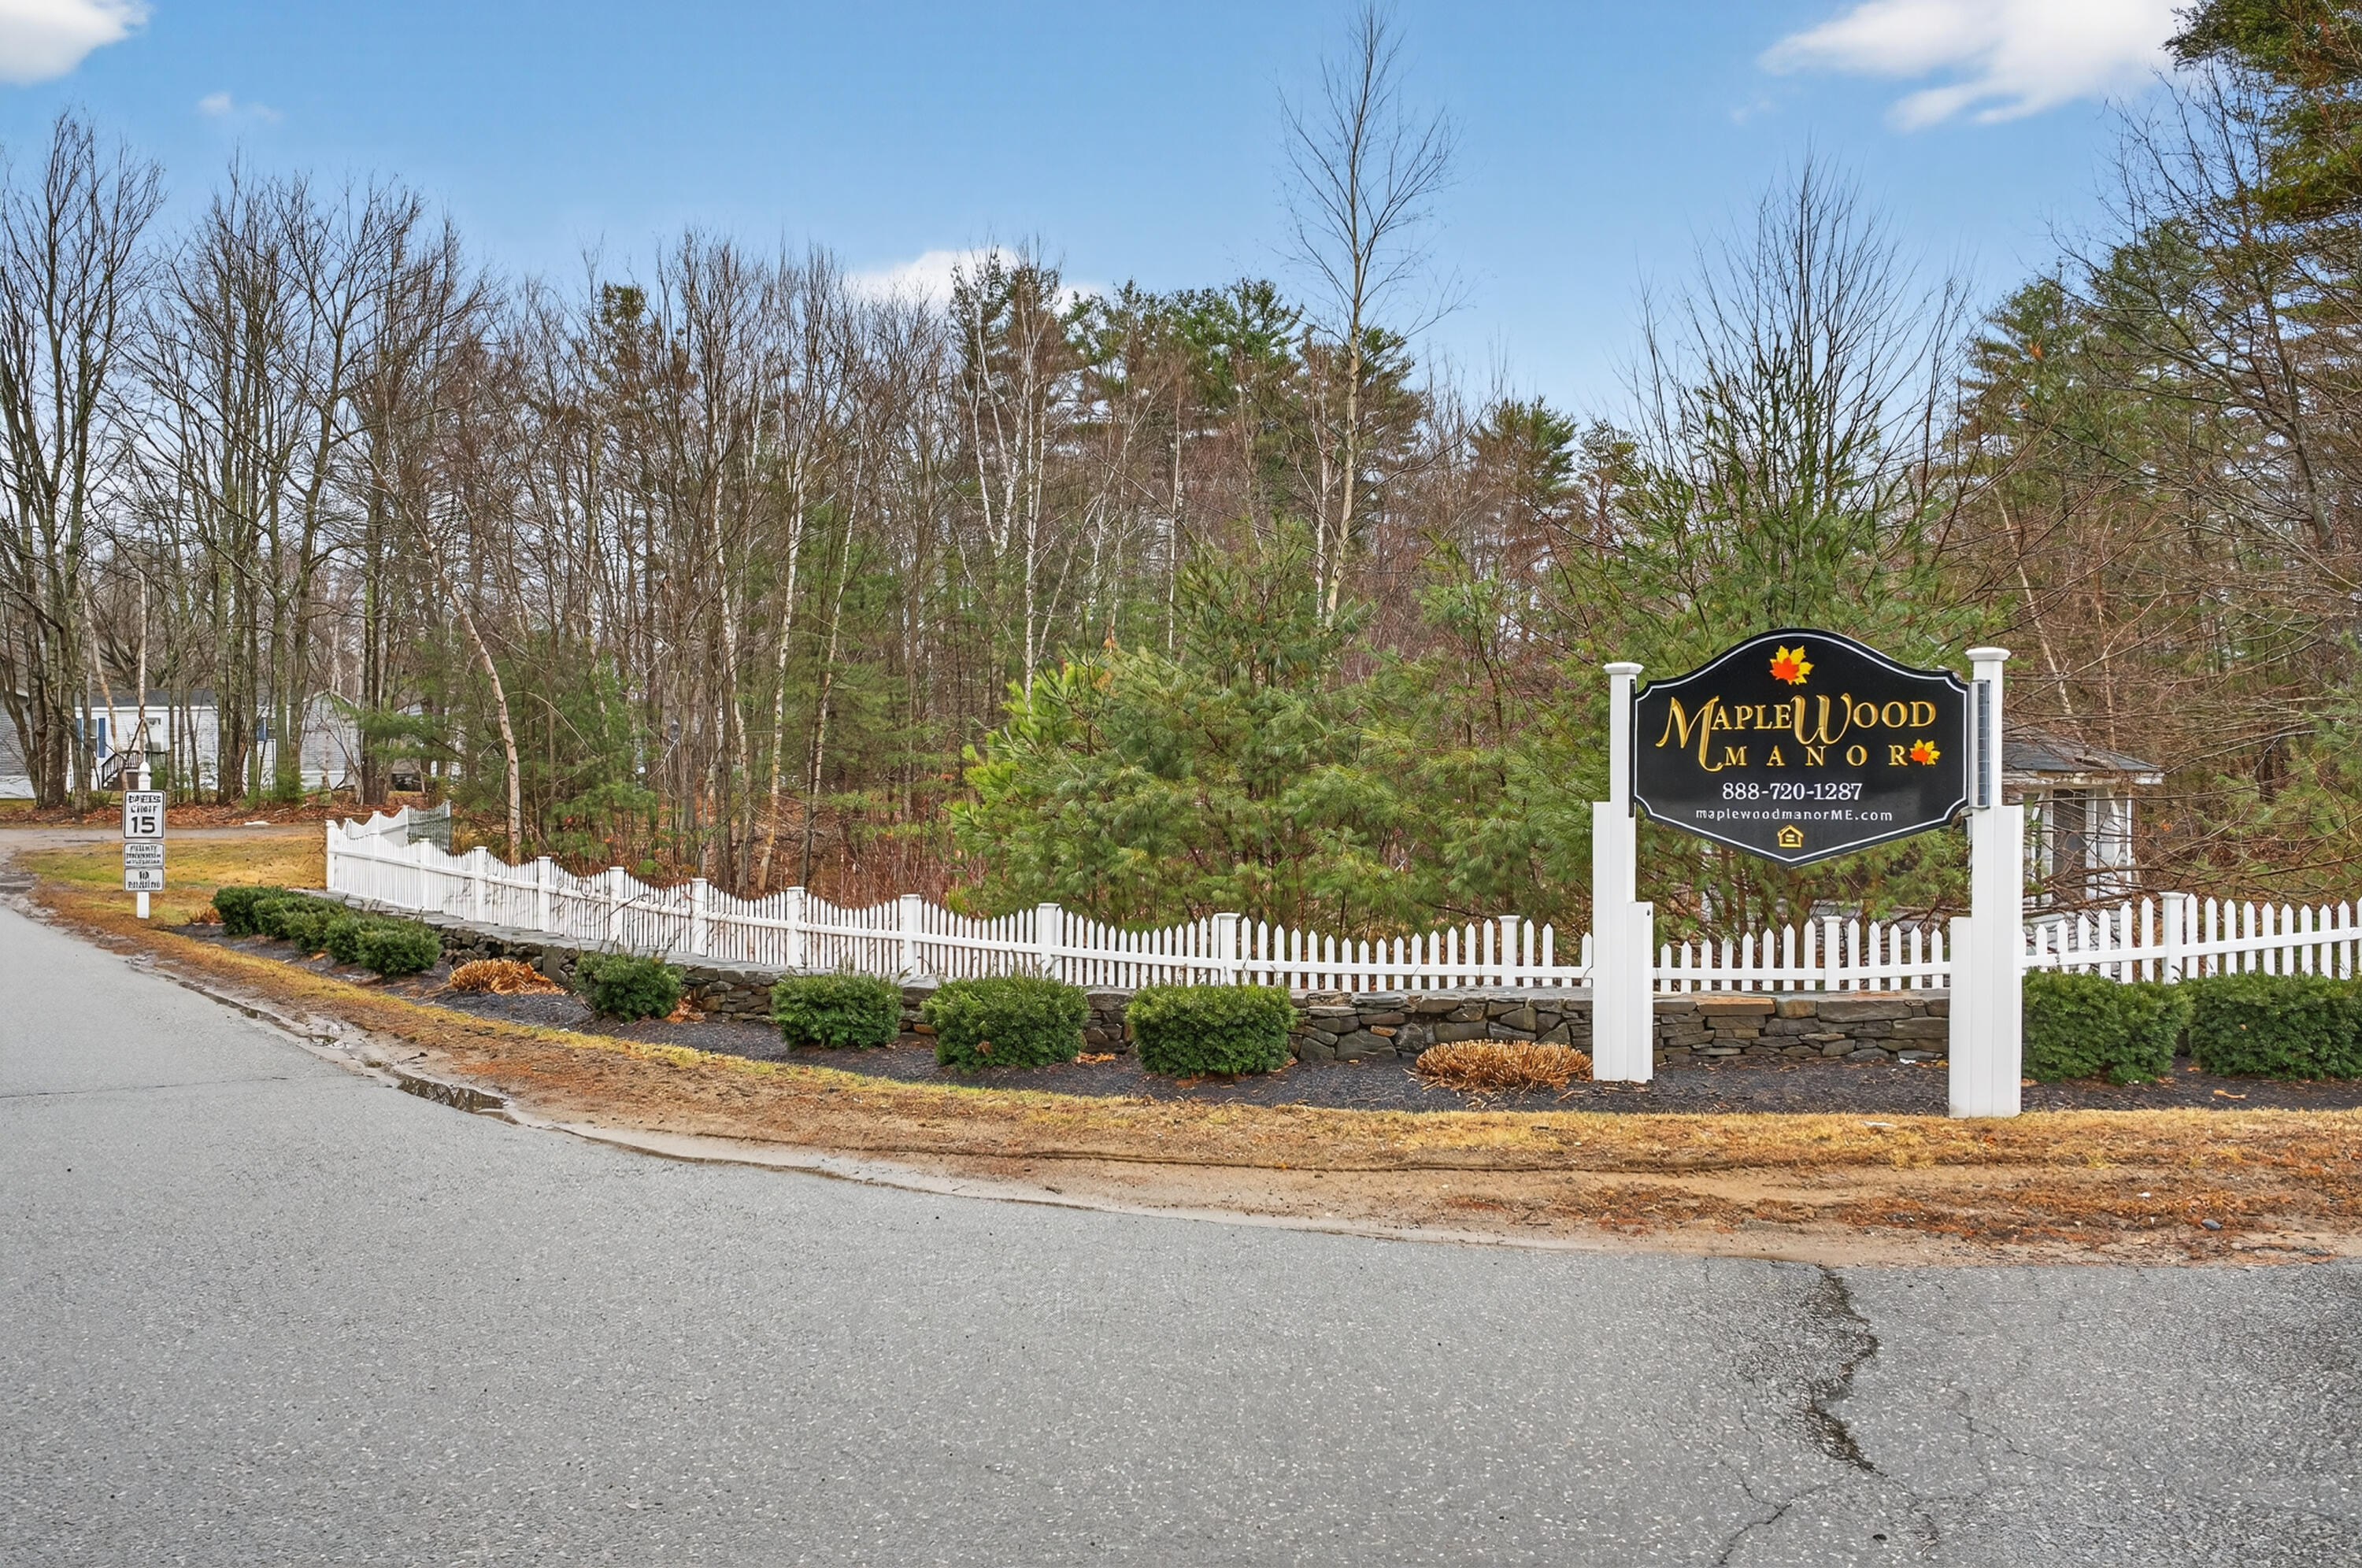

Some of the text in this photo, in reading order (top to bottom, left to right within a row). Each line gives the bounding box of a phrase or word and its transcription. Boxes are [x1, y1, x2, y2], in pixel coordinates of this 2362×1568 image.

[1723, 745, 1909, 767] MANOR
[1722, 782, 1863, 801] 888-720-1287
[131, 815, 155, 834] 15
[1695, 808, 1894, 822] maplewoodmanorME.com
